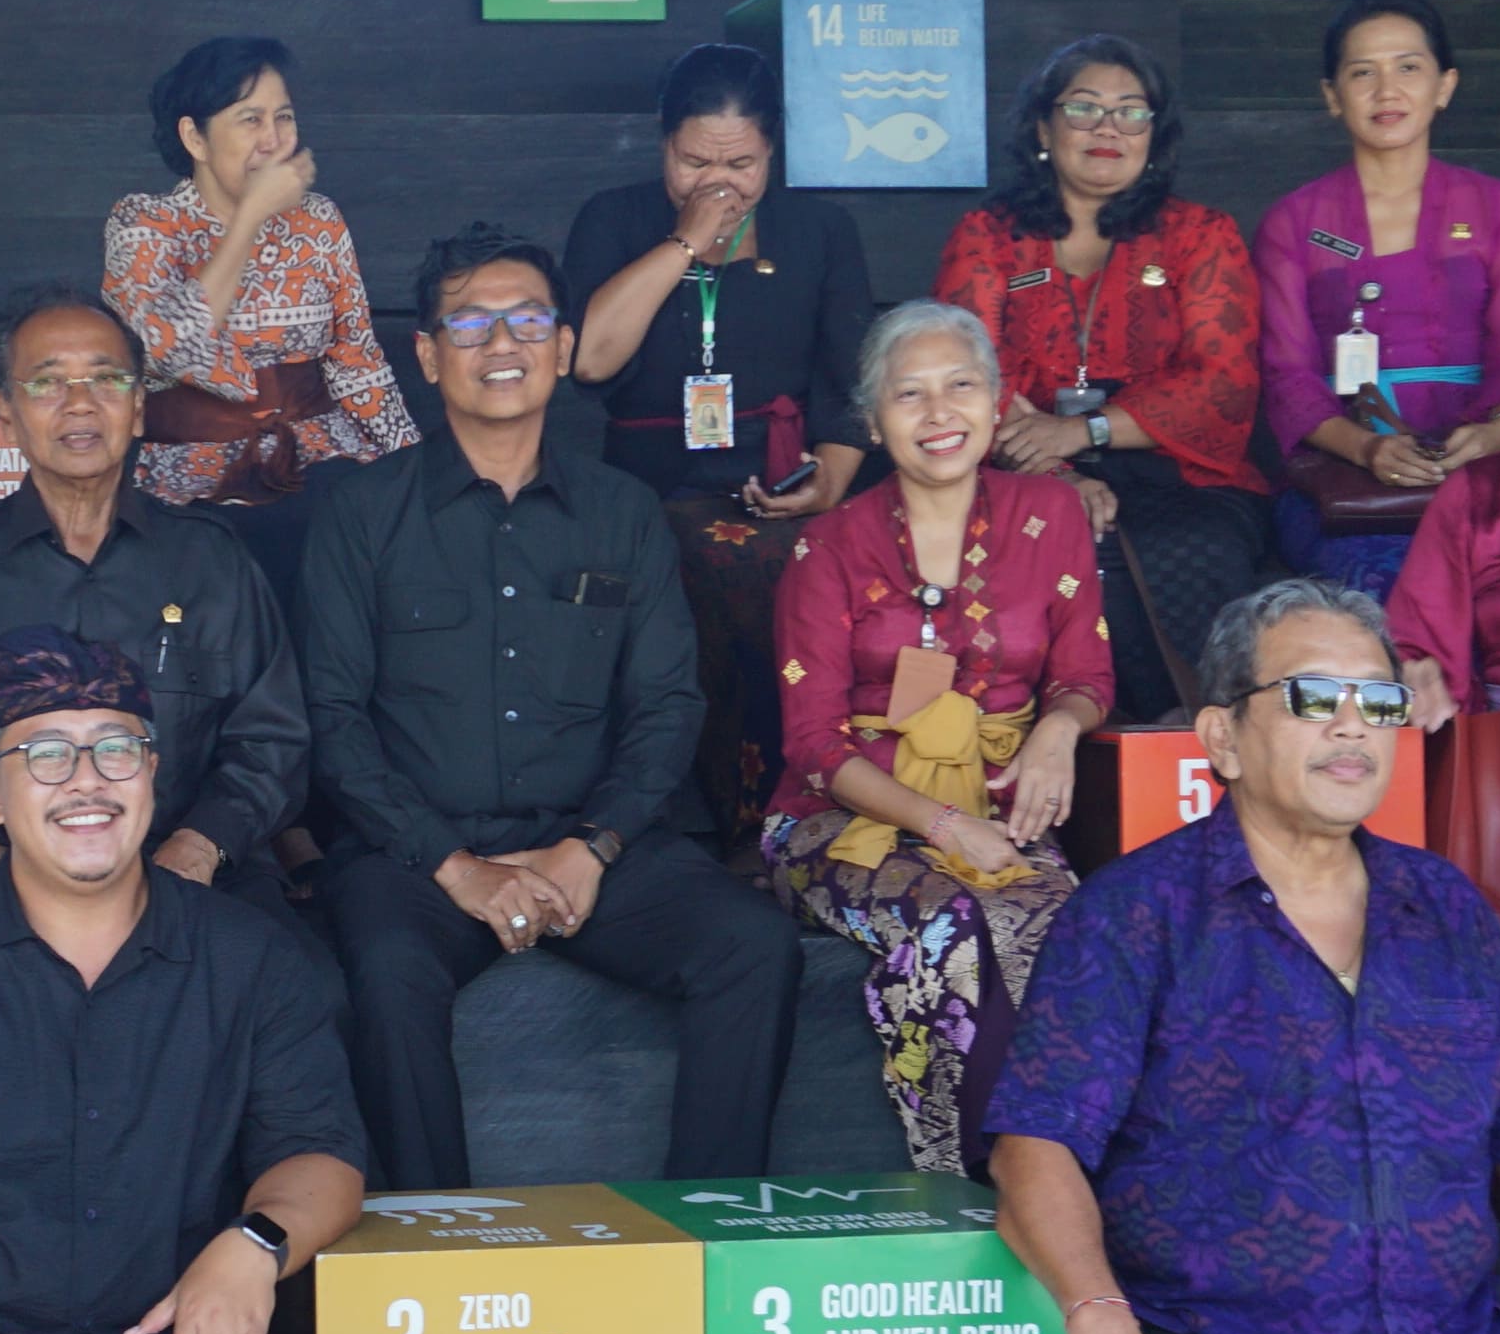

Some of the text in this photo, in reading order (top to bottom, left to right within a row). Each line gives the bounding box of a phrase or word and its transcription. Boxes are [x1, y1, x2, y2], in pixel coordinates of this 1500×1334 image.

[858, 4, 887, 22] LIFE
[807, 4, 845, 47] 14
[859, 28, 960, 46] BELOW WATER
[1178, 758, 1211, 823] 5
[428, 1226, 541, 1237] HUNGER
[479, 1234, 552, 1243] ZERO
[570, 1223, 620, 1239] 2
[821, 1279, 1003, 1320] GOOD HEALTH
[459, 1293, 531, 1331] ZERO
